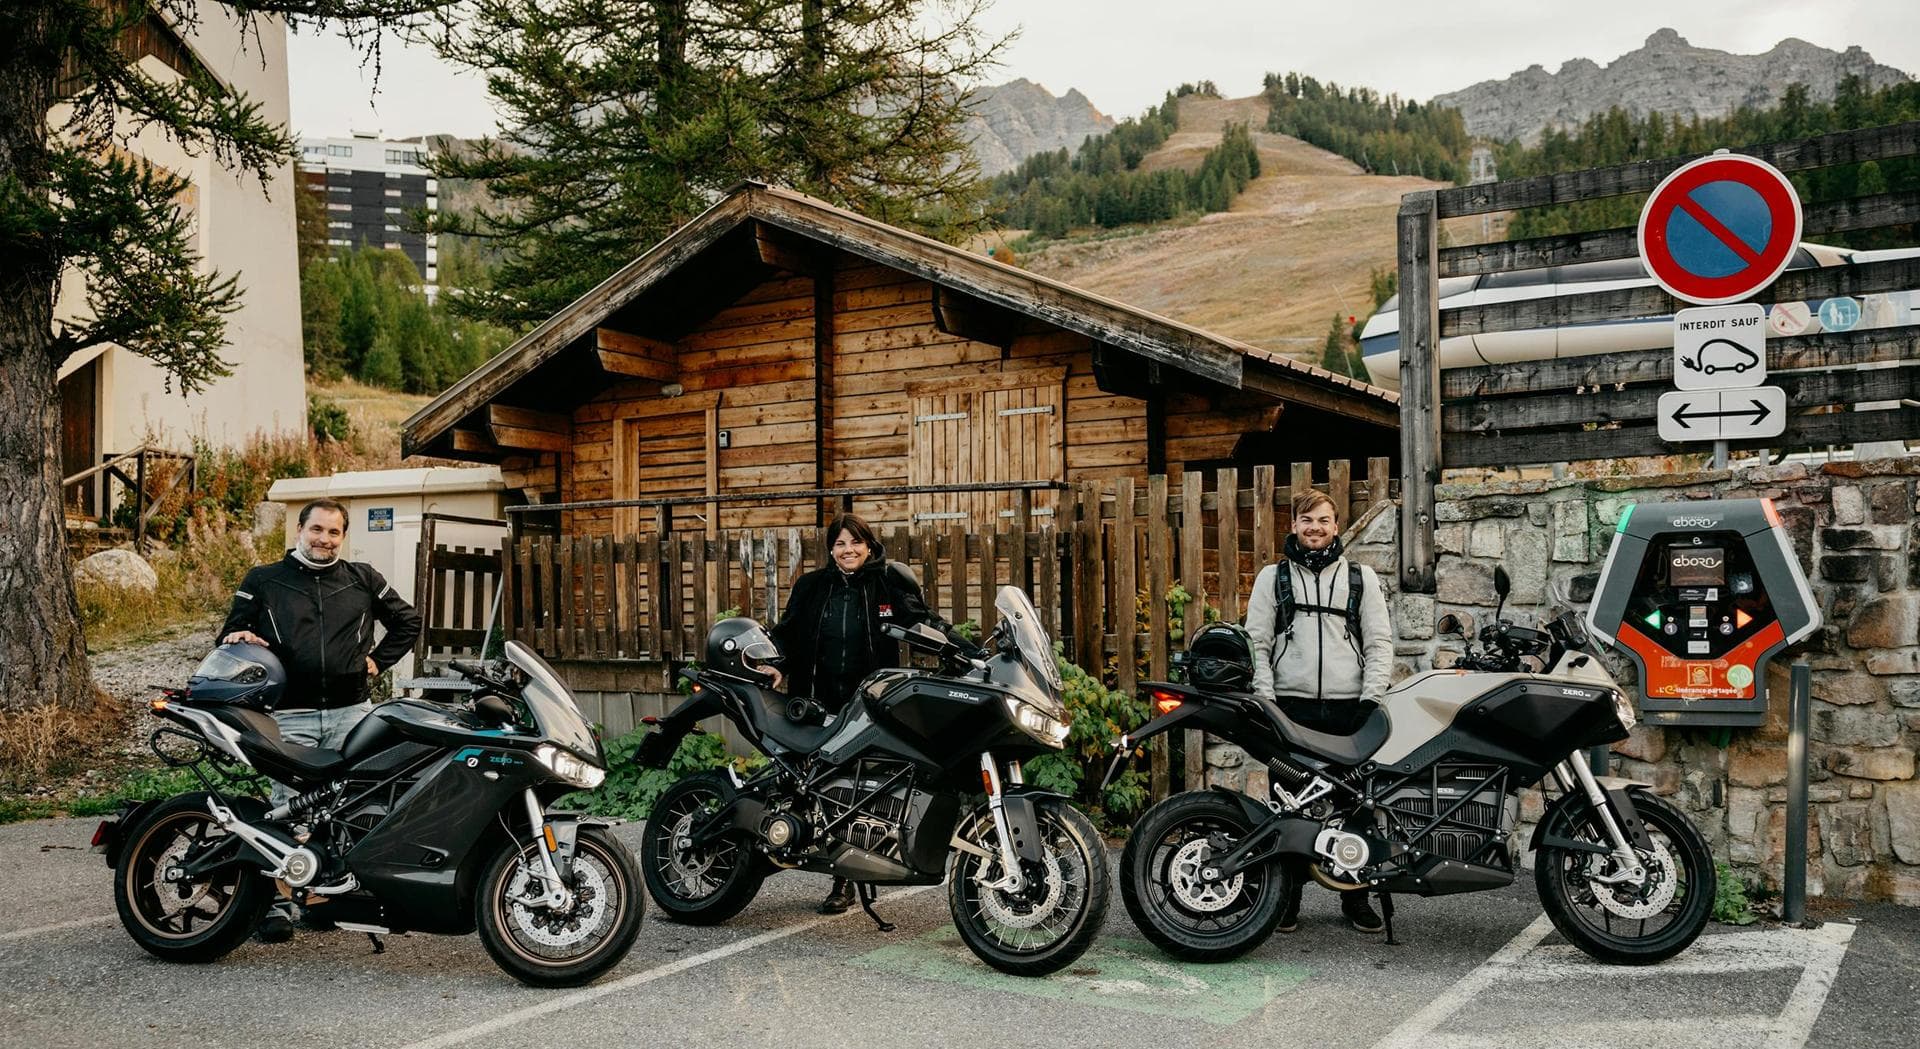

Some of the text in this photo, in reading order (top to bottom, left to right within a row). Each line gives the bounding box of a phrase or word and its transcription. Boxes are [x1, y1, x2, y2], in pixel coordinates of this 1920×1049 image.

[1680, 317, 1759, 331] INTERDIT SAUF
[1673, 516, 1717, 528] eborn
[1673, 554, 1722, 569] eborn
[948, 690, 969, 699] ZERO
[1562, 688, 1585, 697] ZERO
[490, 756, 512, 764] ZERO
